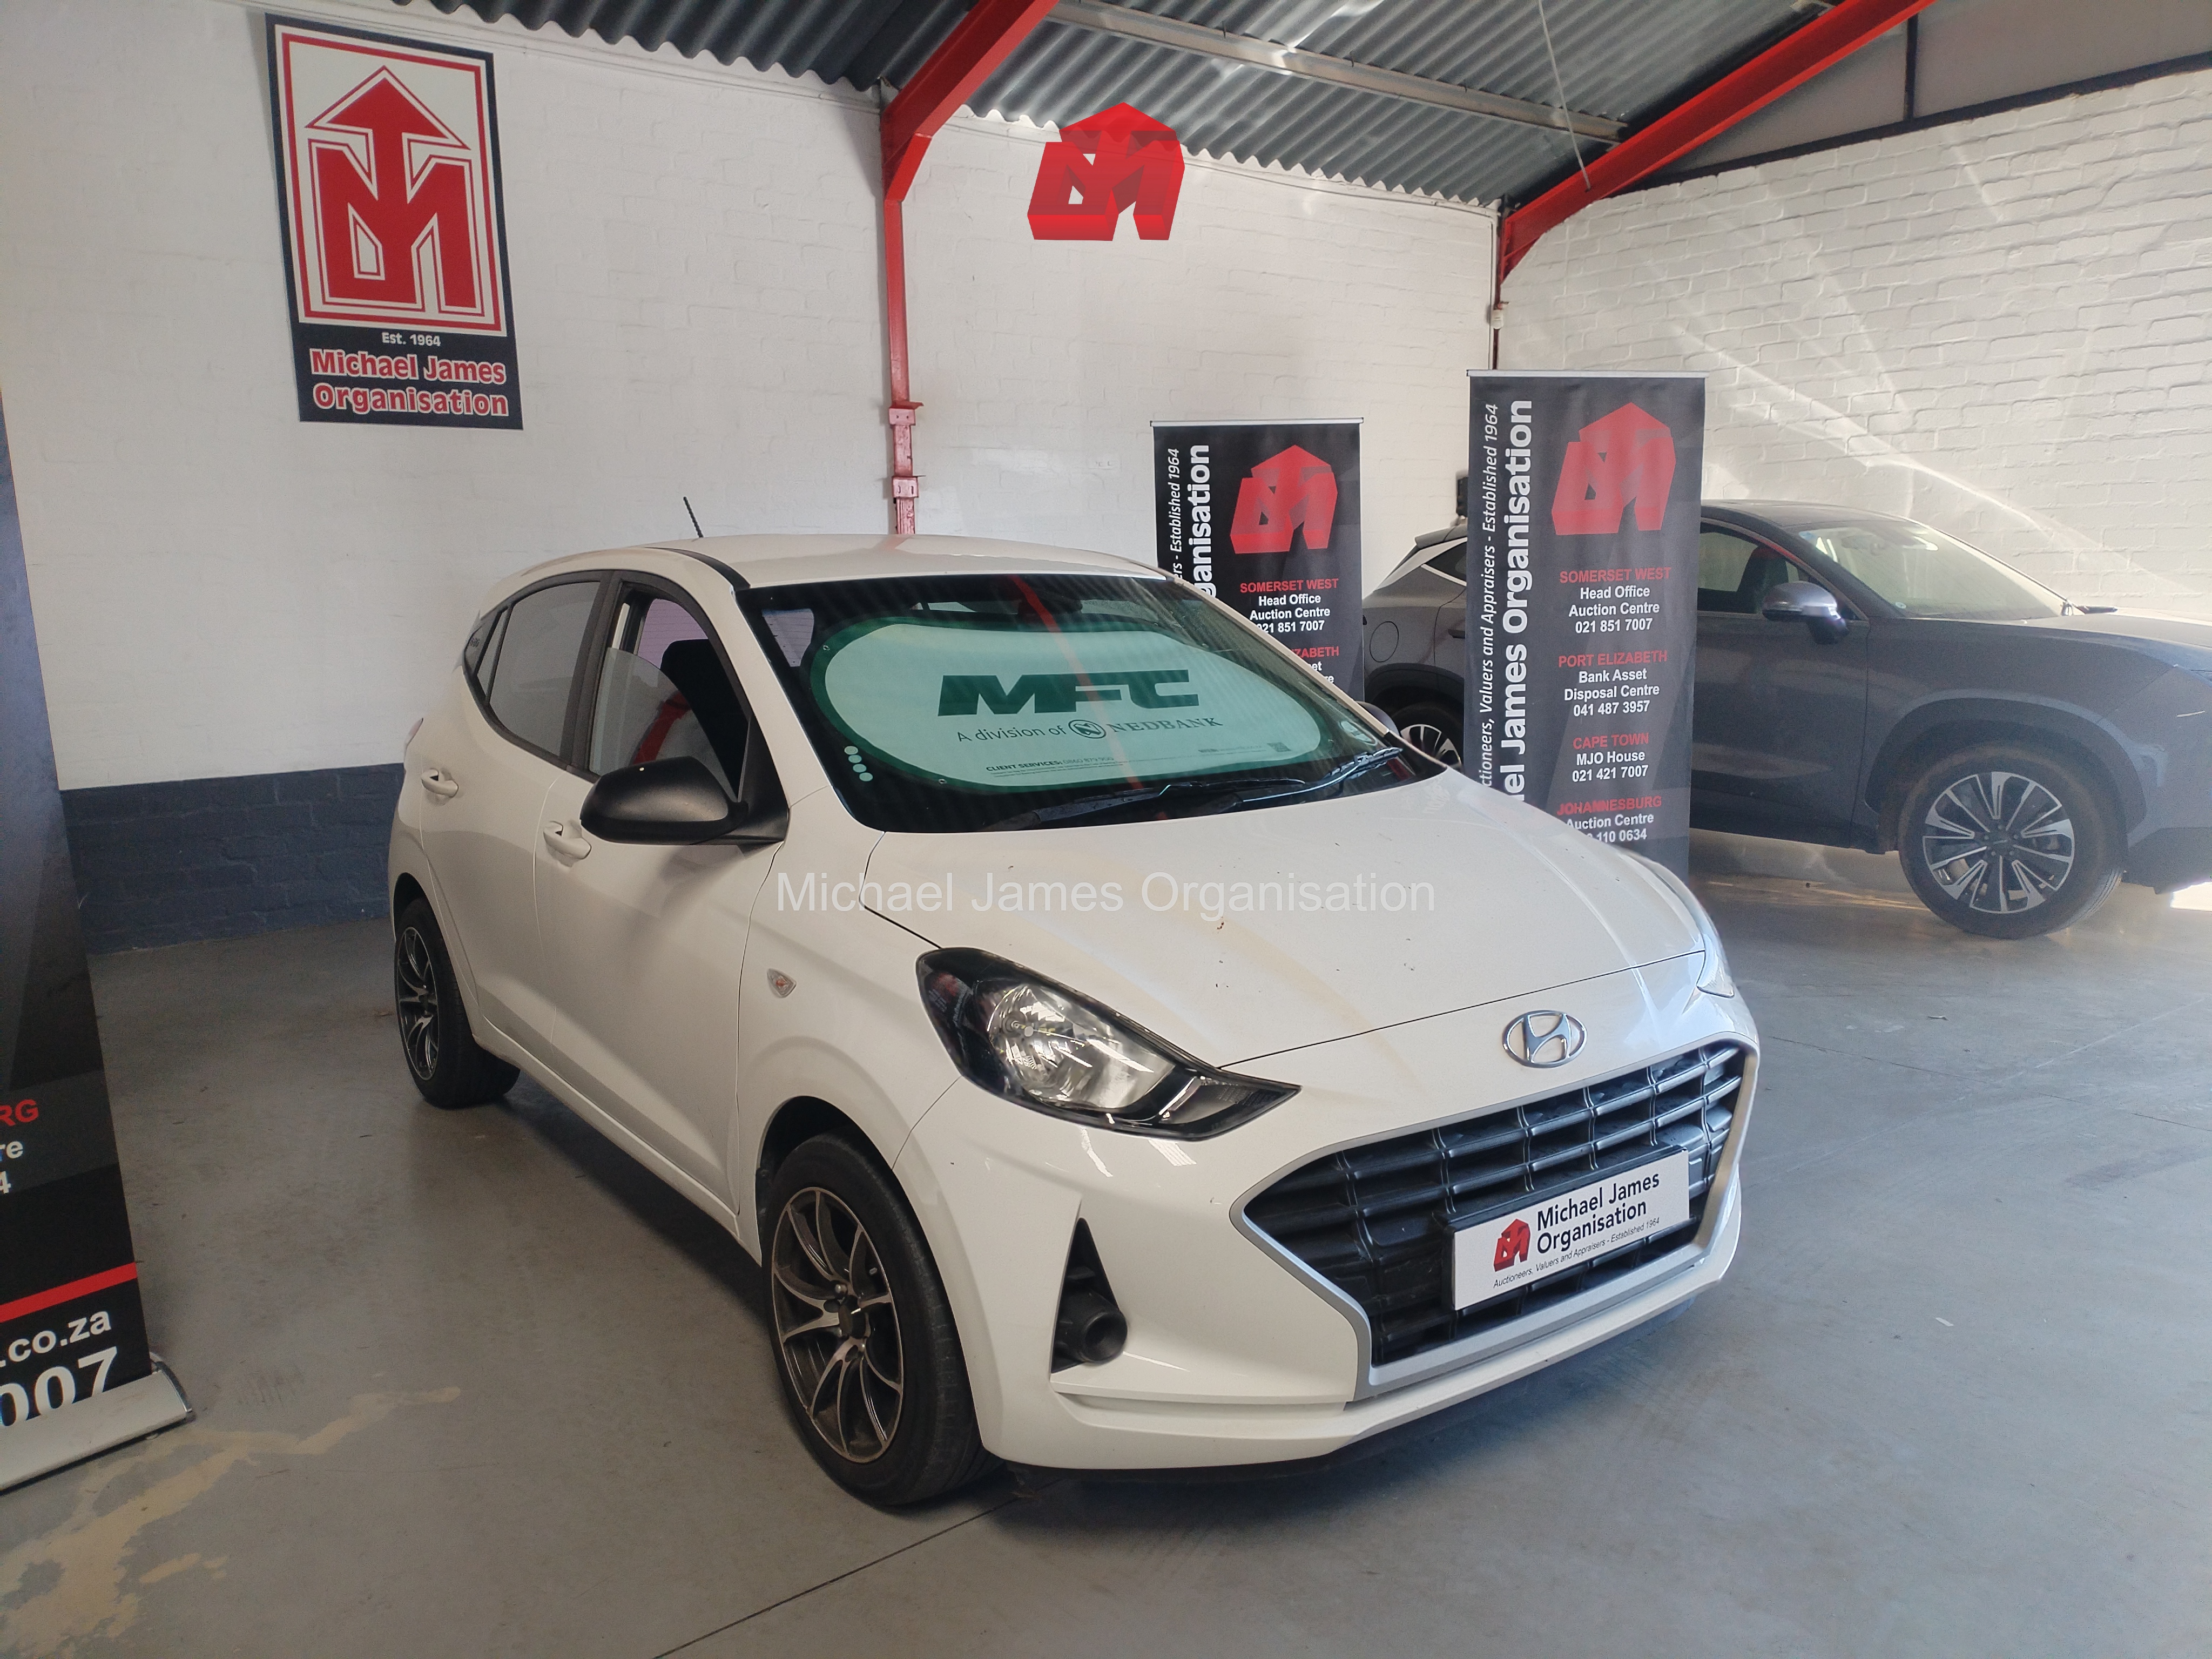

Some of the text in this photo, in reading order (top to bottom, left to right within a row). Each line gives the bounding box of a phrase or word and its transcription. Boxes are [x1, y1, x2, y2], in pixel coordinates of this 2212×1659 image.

[382, 332, 441, 347] Est. 1964
[309, 348, 505, 385] Michael James
[313, 382, 509, 416] Organisation
[1483, 404, 1498, 442] 1964
[1168, 449, 1179, 478] 1964
[1482, 446, 1498, 532] Established
[1169, 482, 1182, 552] Established
[1502, 400, 1533, 633] Organisation
[1560, 567, 1671, 583] SOMERSET WEST
[1240, 578, 1339, 593] SOMERSET WEST
[1481, 545, 1496, 624] Appraisers
[1580, 585, 1650, 599] Head Office
[1259, 594, 1321, 606] Head Office
[1250, 607, 1330, 621] Auction Centre
[1569, 602, 1660, 617] Auction Centre
[1278, 622, 1296, 632] 851
[1300, 621, 1325, 631] 7007
[1575, 618, 1653, 633] 021 851 7007
[1480, 627, 1494, 656] and
[1291, 646, 1339, 658] ZABETH
[1559, 650, 1667, 667] PORT ELIZABETH
[1579, 668, 1647, 683] Bank Asset
[938, 670, 1199, 717] MFC
[1479, 659, 1494, 713] Valuers
[1564, 685, 1660, 702] Disposal Centre
[1501, 645, 1527, 755] James
[1573, 700, 1650, 717] 041 487 3957
[957, 717, 1223, 742] A division of NEDBANK
[1573, 733, 1649, 750] CAPE TOWN
[1576, 751, 1645, 765] MJO House
[1572, 765, 1648, 782] 021 421 7007
[1557, 795, 1662, 815] JOHANNESBURG
[1615, 813, 1654, 826] Centre
[1620, 828, 1647, 841] 0634
[1537, 1174, 1660, 1231] Michael James
[1537, 1201, 1647, 1254] Organisation
[1493, 1269, 1533, 1289] Auctioneers,
[1536, 1257, 1559, 1272] Valuers
[1560, 1251, 1573, 1263] and
[1573, 1239, 1606, 1259] Appraisers
[1611, 1223, 1644, 1243] Established
[1646, 1217, 1660, 1230] 1964
